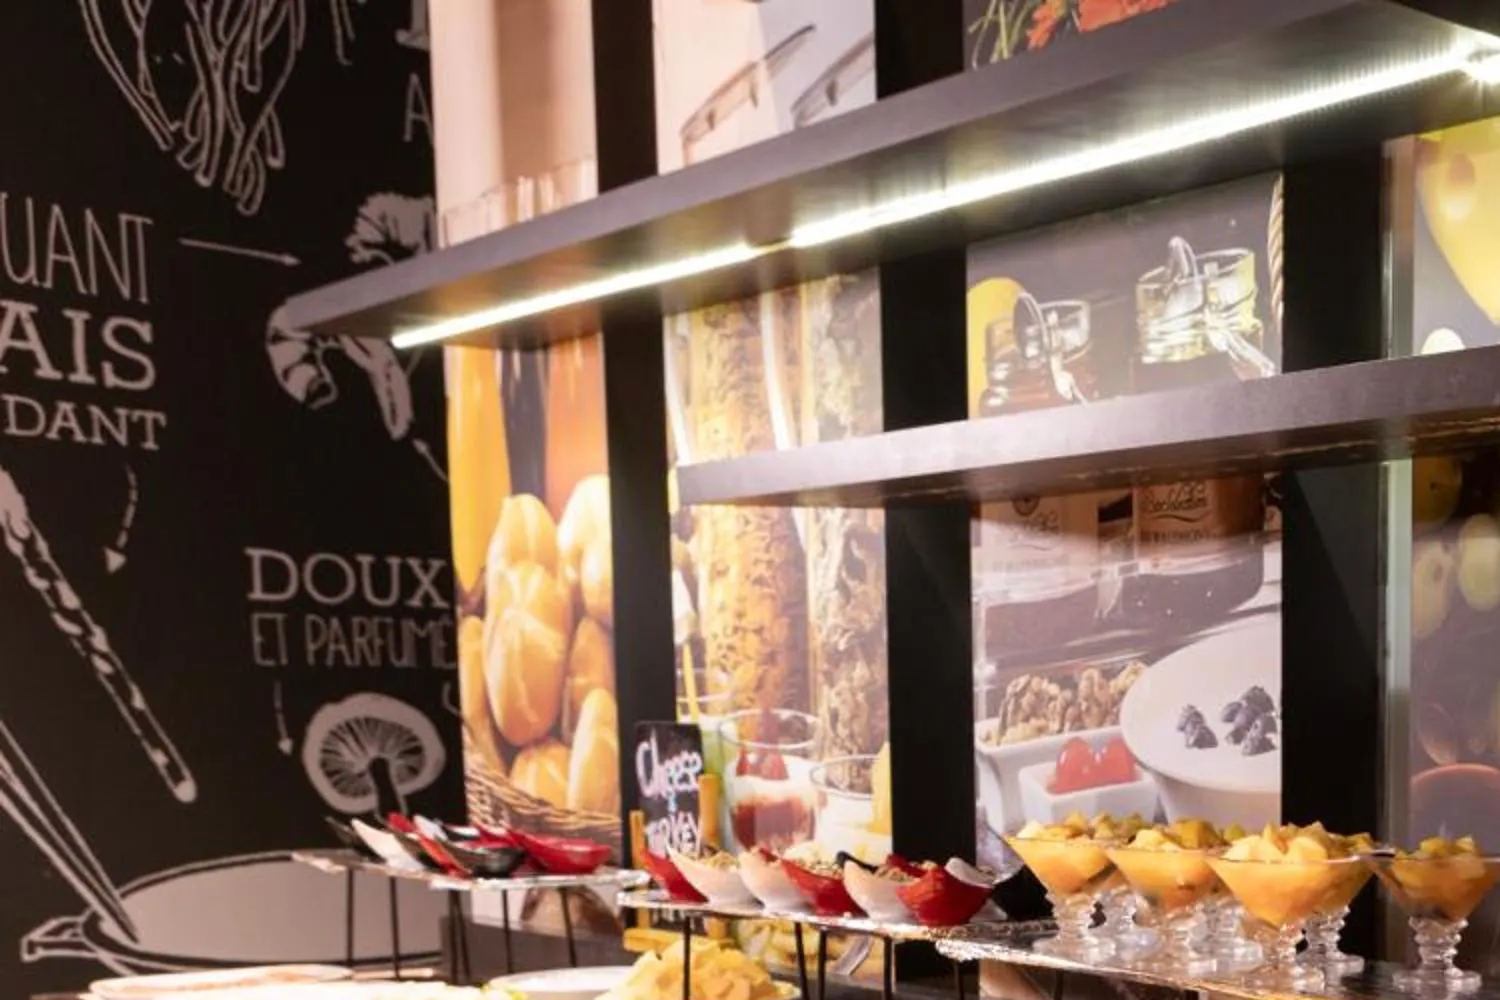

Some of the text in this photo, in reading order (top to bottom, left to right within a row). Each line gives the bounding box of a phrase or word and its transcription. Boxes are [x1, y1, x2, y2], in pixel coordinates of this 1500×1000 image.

[0, 299, 156, 391] AIS
[0, 394, 167, 451] DANT
[245, 547, 450, 608] DOUX
[251, 612, 289, 667] ET
